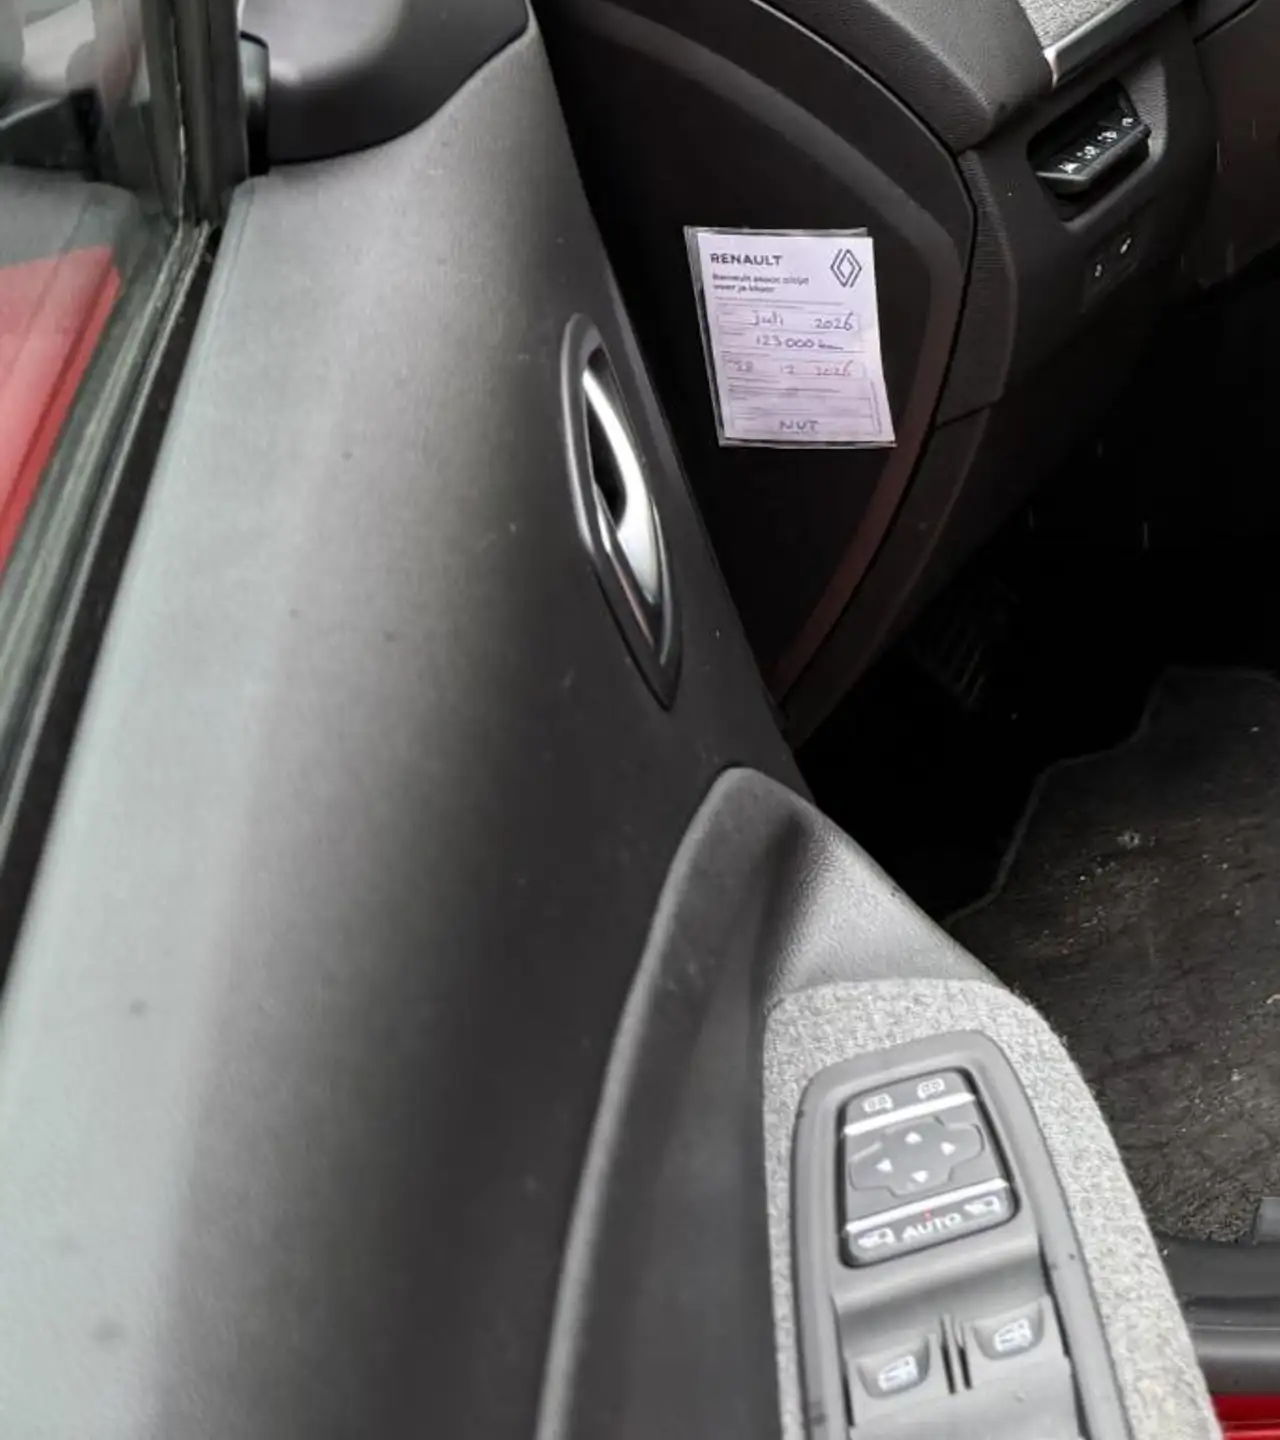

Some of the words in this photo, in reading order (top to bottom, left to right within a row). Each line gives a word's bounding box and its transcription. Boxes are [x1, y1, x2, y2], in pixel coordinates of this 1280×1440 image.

[709, 252, 783, 266] RENAULT
[814, 312, 854, 331] 2026
[902, 1212, 962, 1244] AUTO
